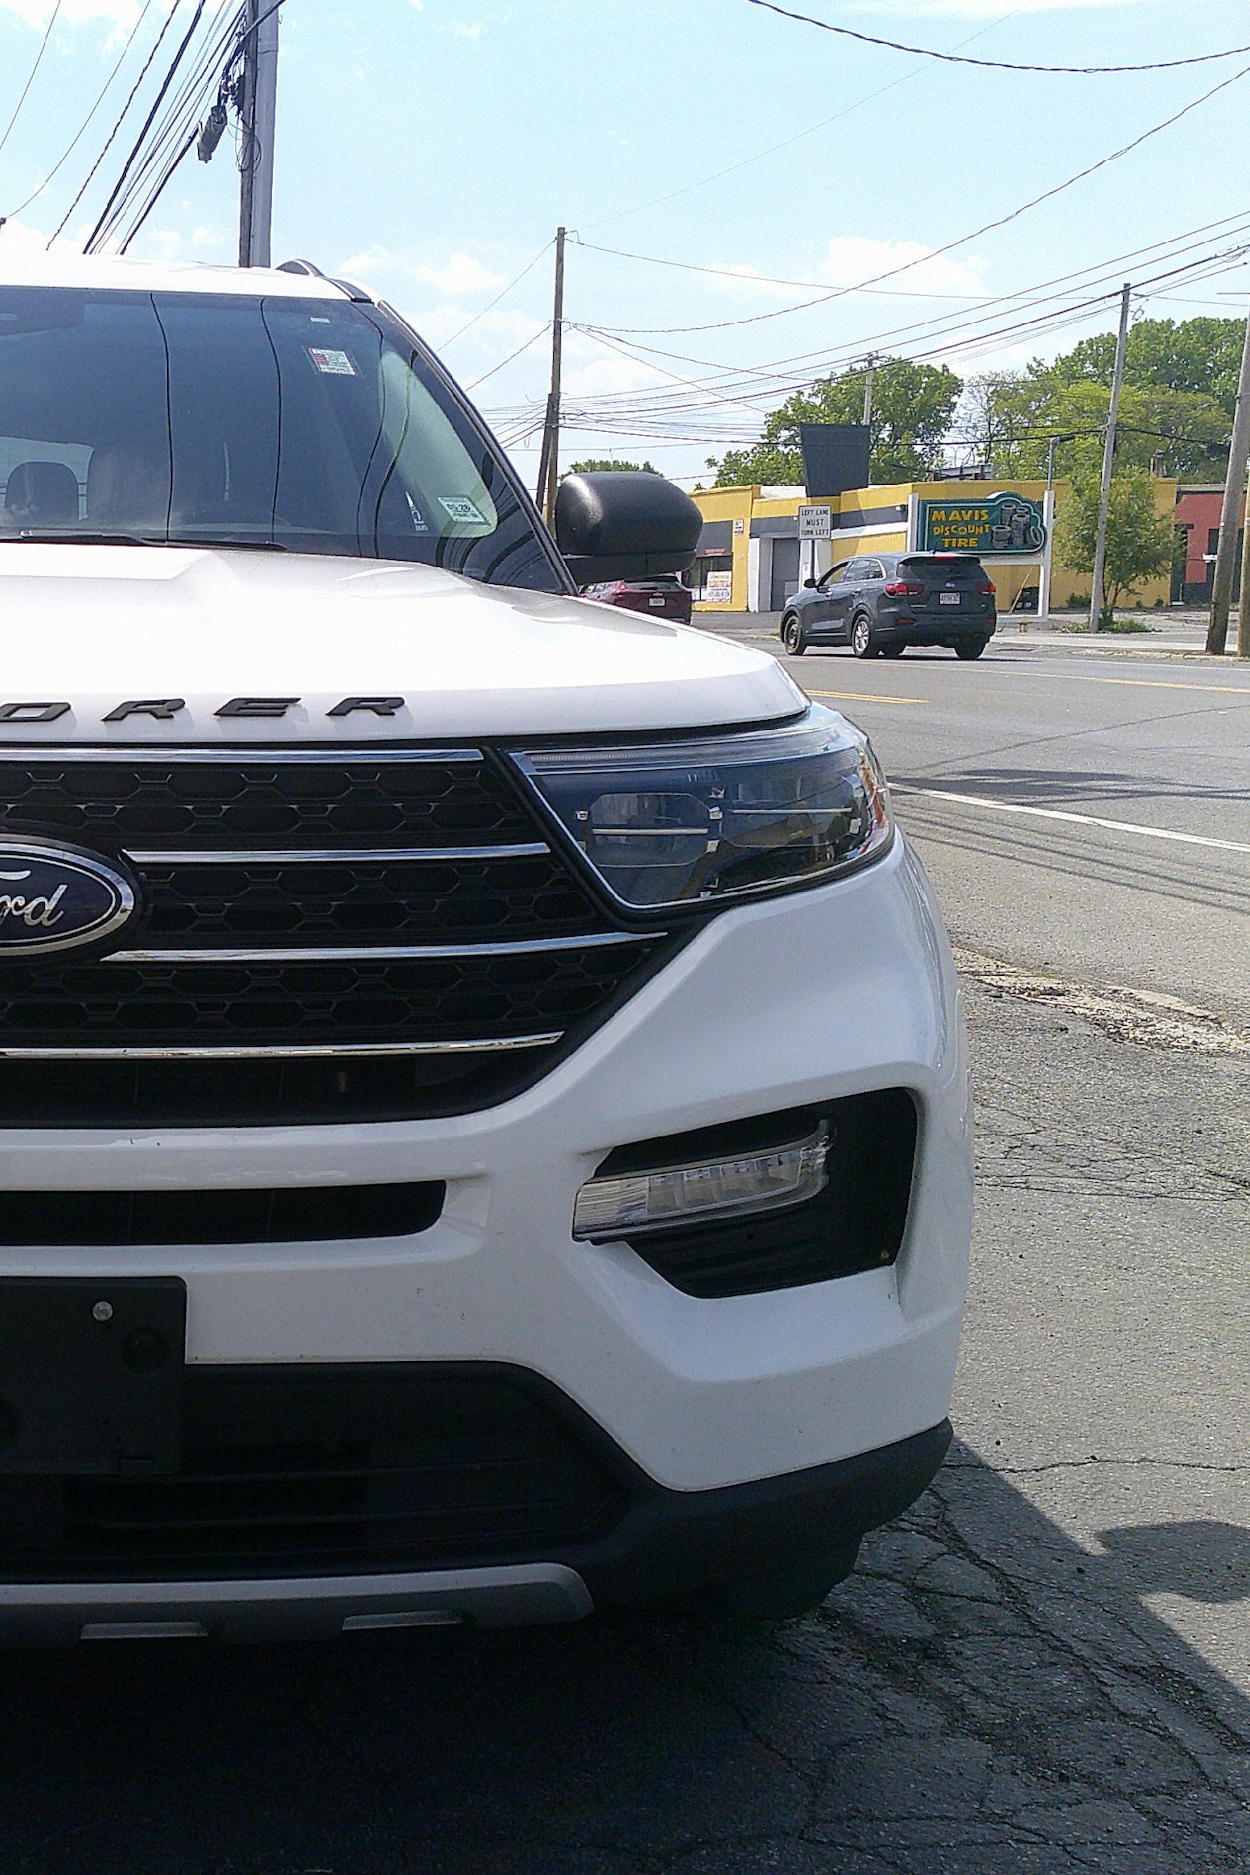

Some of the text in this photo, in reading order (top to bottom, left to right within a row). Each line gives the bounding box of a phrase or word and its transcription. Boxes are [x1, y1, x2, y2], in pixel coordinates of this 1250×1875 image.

[931, 509, 990, 522] MAVIS
[806, 518, 825, 526] MUST
[932, 524, 991, 536] DISCOUNT
[941, 537, 978, 548] TIRE
